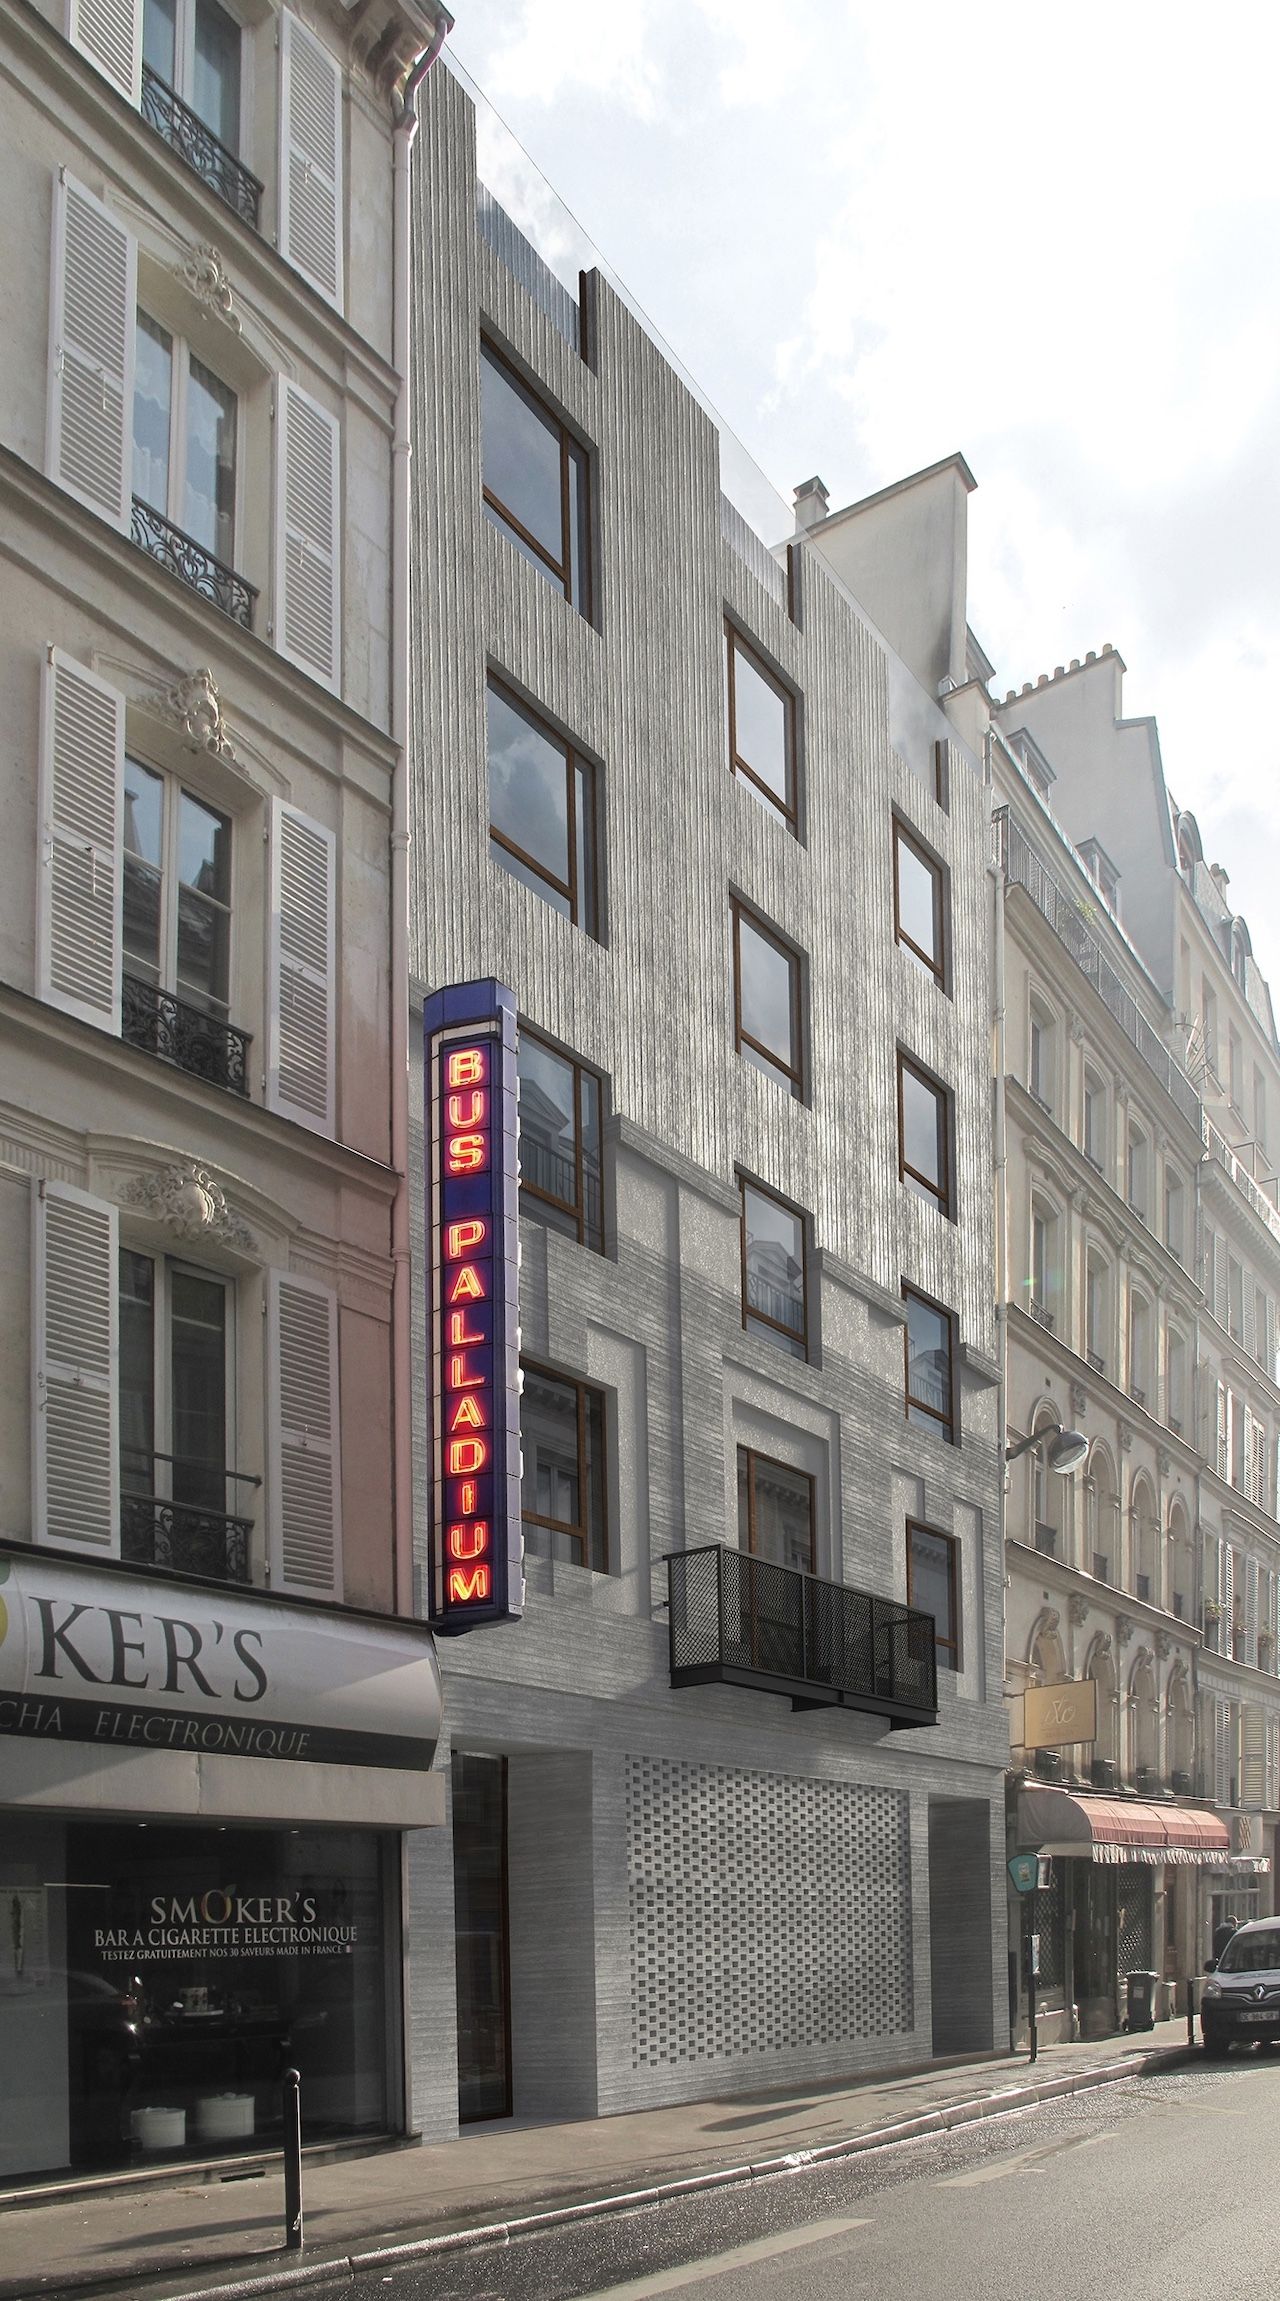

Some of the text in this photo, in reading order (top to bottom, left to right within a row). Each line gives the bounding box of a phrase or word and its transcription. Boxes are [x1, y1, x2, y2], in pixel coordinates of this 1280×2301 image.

[448, 1050, 487, 1602] BUS PALLADIUM
[0, 1594, 268, 1703] KER'S
[93, 1710, 311, 1757] ELECTRONIQUE
[150, 1888, 317, 1925] SMOKER'S
[94, 1926, 358, 1947] BAR A CIGARETTE ELECTRONIQUE
[101, 1944, 342, 1960] TESTEZ GRATUITEMENT NOS 30 SAVEURS MADE IN FRANCE
